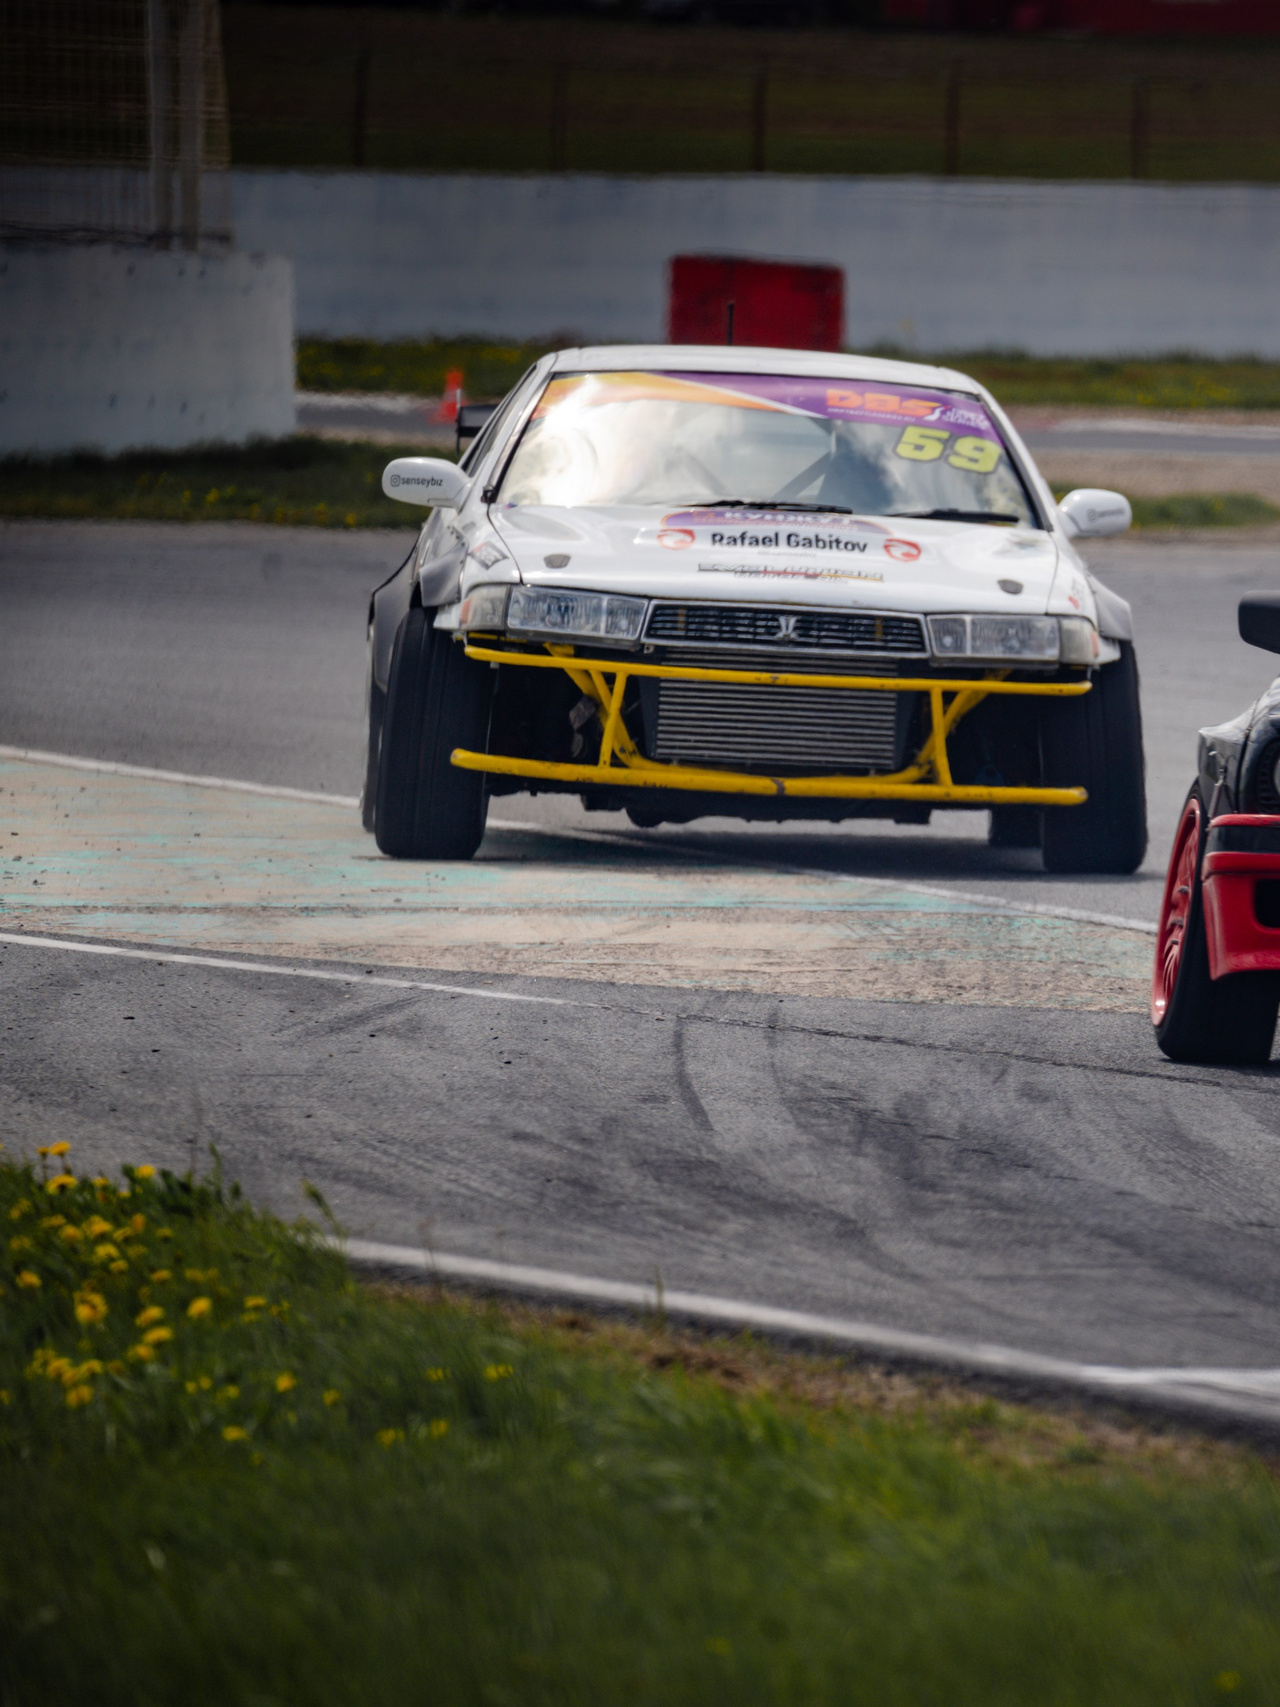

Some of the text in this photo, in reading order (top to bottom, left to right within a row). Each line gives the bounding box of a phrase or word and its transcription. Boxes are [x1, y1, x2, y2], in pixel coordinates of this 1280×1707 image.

[895, 425, 1003, 474] 59
[401, 476, 443, 487] senseybiz
[711, 531, 868, 553] Rafael Gabitov
